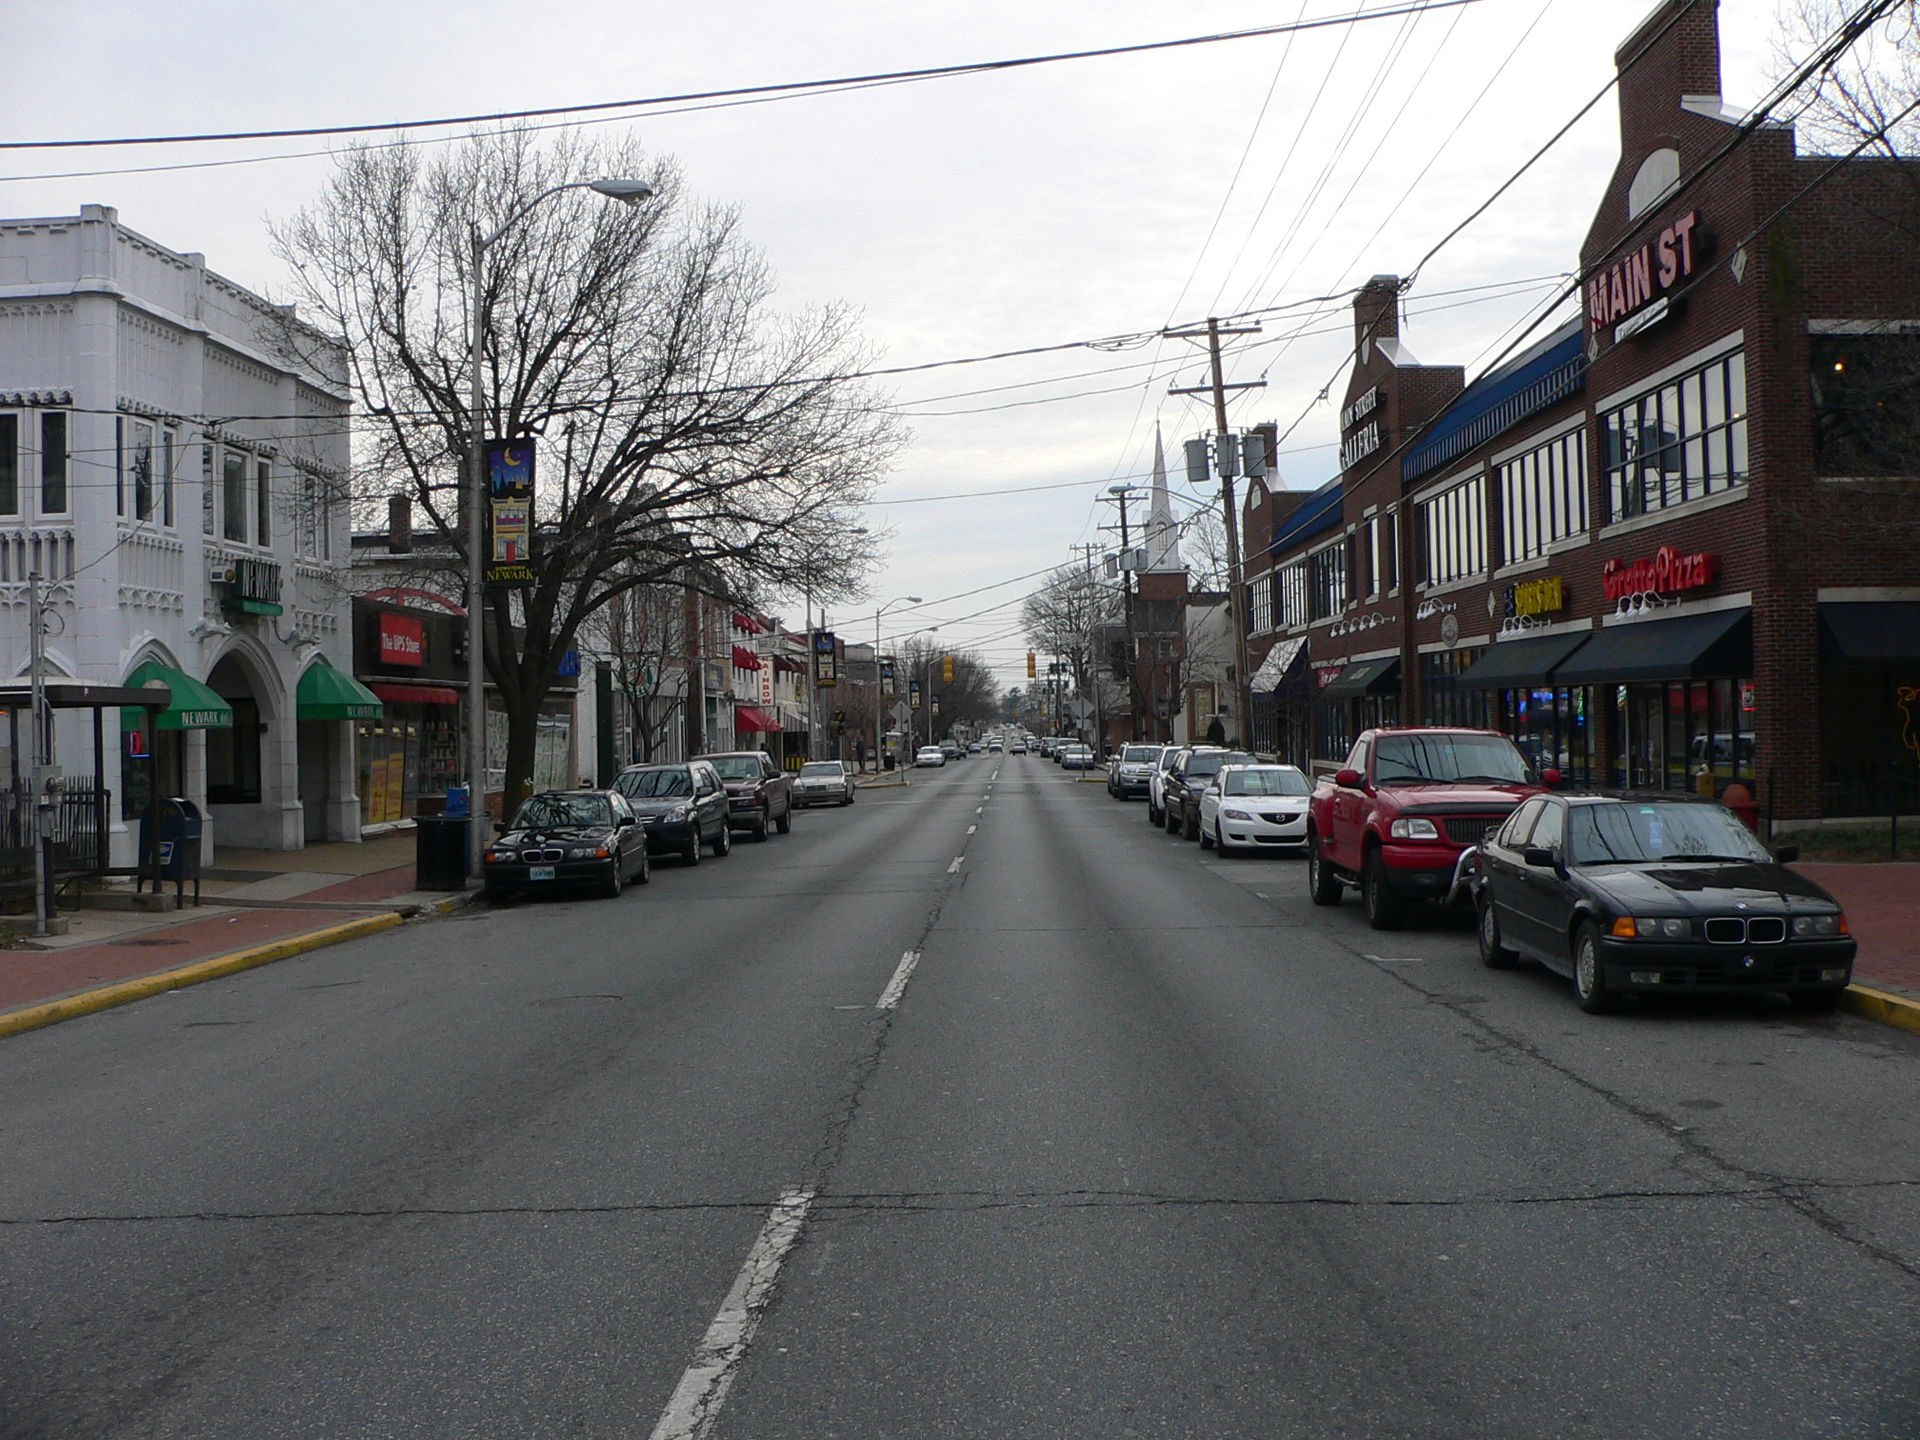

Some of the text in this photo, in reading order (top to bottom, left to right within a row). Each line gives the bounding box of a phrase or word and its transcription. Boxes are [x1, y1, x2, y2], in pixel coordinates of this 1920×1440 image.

[1589, 244, 1652, 333] MAIN
[1658, 211, 1696, 289] ST
[1355, 385, 1377, 421] STREET
[1339, 420, 1380, 472] GALLERIA
[242, 558, 282, 600] NEWARK
[486, 568, 534, 581] NEWARK
[1604, 558, 1657, 600] Grotto
[1656, 547, 1709, 592] Pizza
[382, 632, 420, 653] The UPS Store
[182, 711, 218, 725] NEWARK
